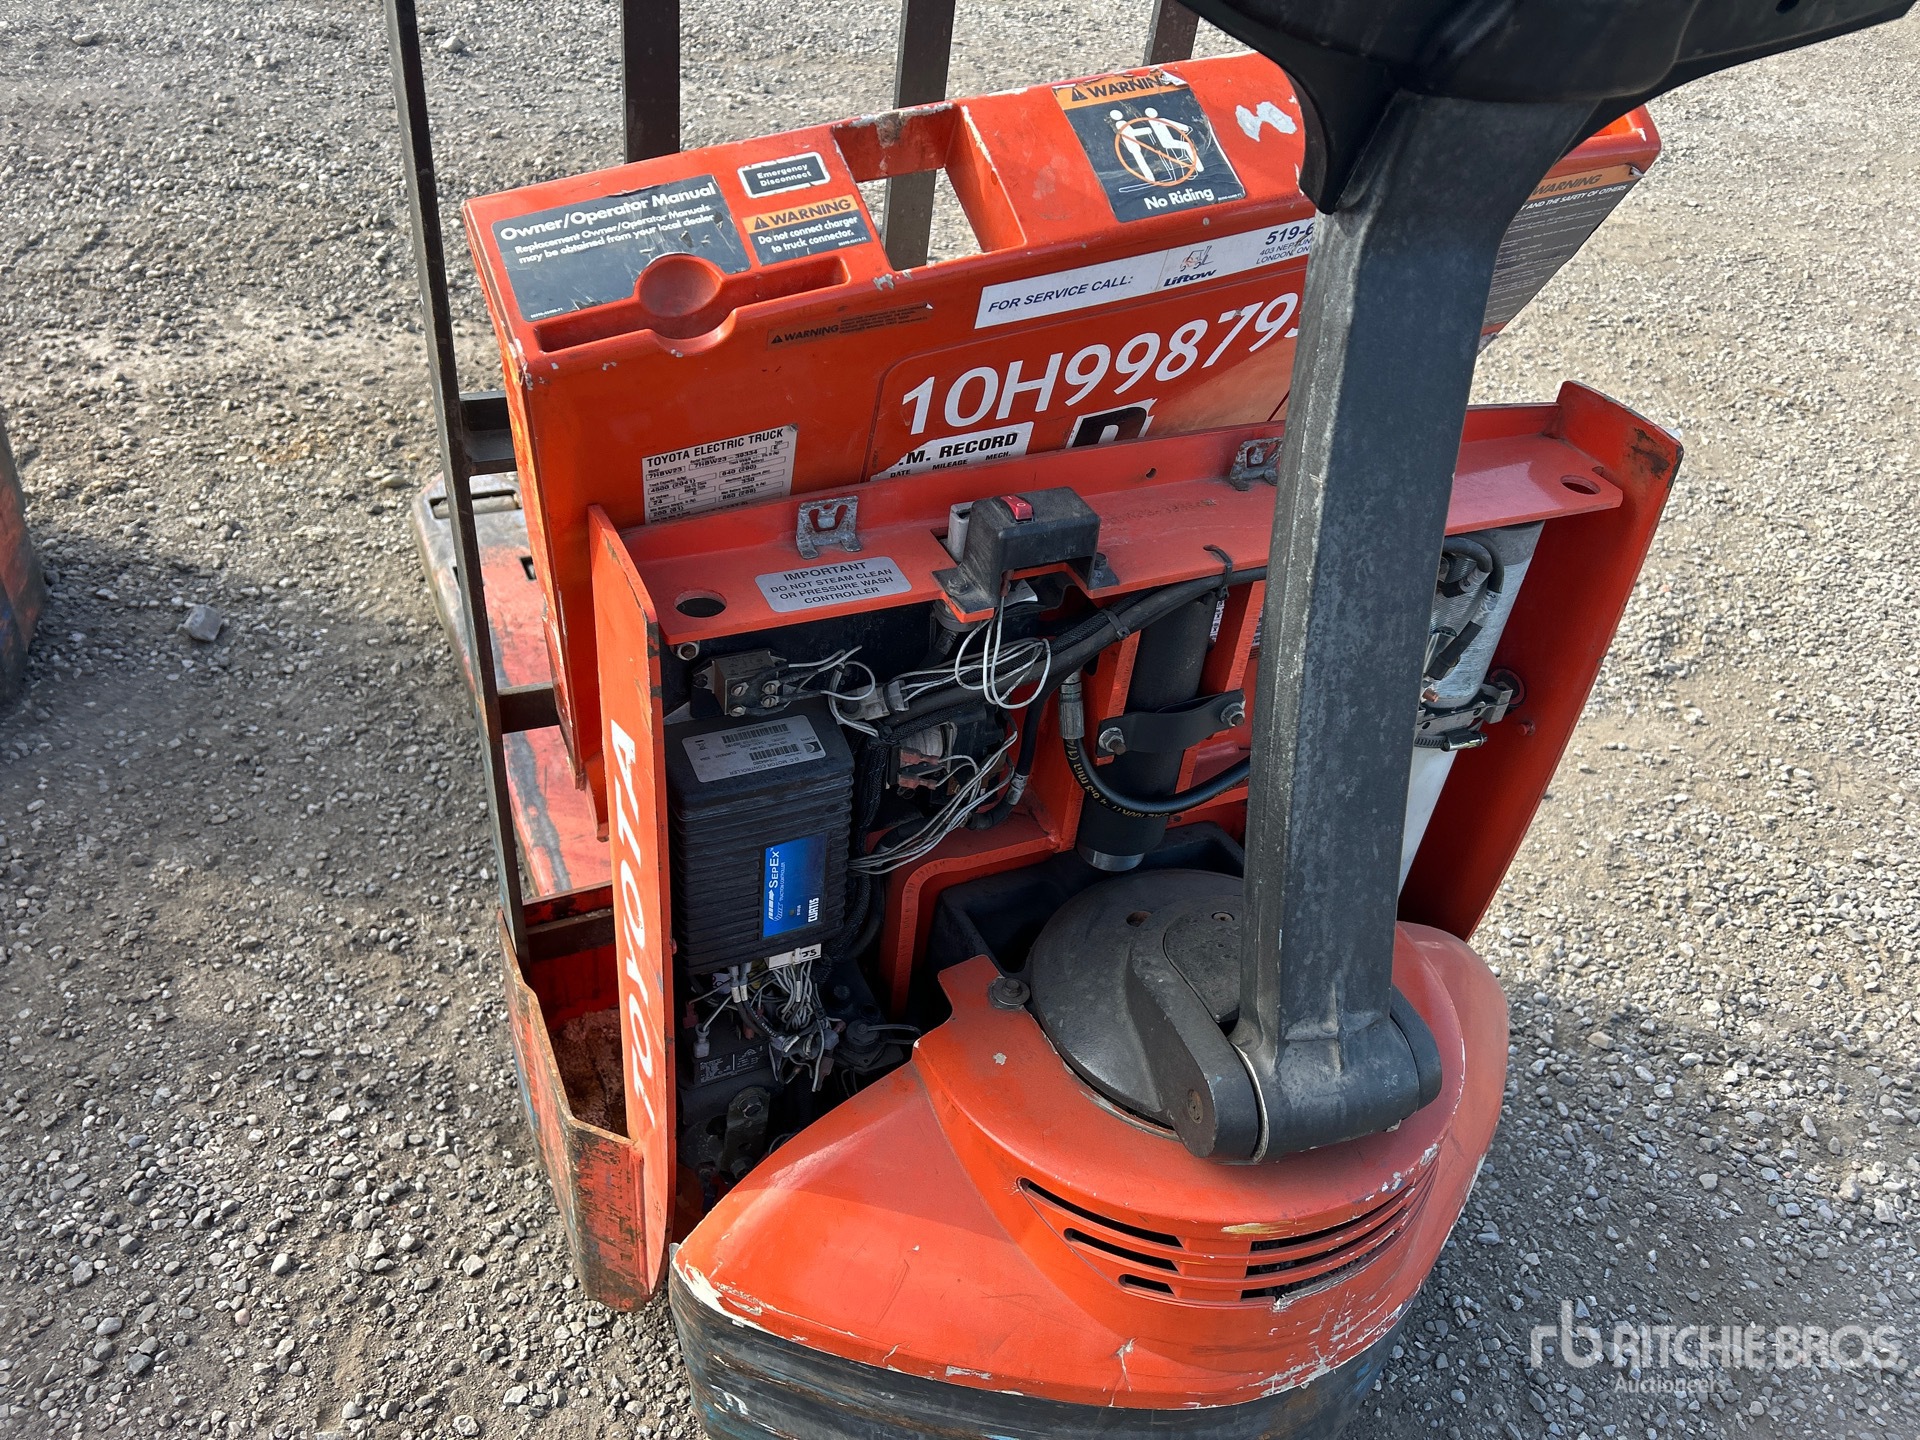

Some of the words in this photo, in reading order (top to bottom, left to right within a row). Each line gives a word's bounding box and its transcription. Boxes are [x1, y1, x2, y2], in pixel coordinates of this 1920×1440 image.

[1087, 74, 1167, 98] WARNIN
[756, 163, 808, 179] Emergency
[760, 170, 812, 187] Disconnect
[1526, 201, 1545, 210] AND
[1546, 198, 1560, 206] THE
[1560, 191, 1586, 203] SAFETY
[1586, 189, 1599, 197] OF
[1599, 184, 1628, 195] OTHERS
[1532, 174, 1603, 196] WARNING
[1144, 194, 1167, 210] No
[1174, 186, 1215, 205] Riding
[500, 198, 648, 241] Owner/Operator
[652, 182, 717, 207] Manual
[769, 199, 851, 226] WARNING
[514, 232, 580, 254] Replacement
[582, 213, 667, 239] Owner/Operator
[668, 203, 711, 219] Manuals
[518, 252, 542, 265] may
[544, 246, 559, 257] be
[560, 237, 606, 255] obtained
[606, 230, 632, 245] from
[632, 225, 657, 240] your
[658, 220, 682, 232] local
[682, 213, 714, 228] dealer
[757, 235, 772, 245] Do
[772, 230, 789, 240] not
[790, 223, 823, 238] connect
[824, 216, 858, 231] charger
[771, 245, 782, 254] to
[783, 238, 807, 251] truck
[808, 229, 855, 245] connector.
[1163, 268, 1217, 287] Liftow
[987, 297, 1022, 313] FOR
[1023, 283, 1088, 306] SERVICE
[1091, 275, 1134, 291] CALL:
[784, 324, 839, 342] WARNING
[902, 293, 1299, 435] 10H99879
[647, 451, 690, 468] TOYOTA
[694, 437, 745, 457] ELECTRIC
[748, 428, 784, 445] TRUCK
[898, 449, 932, 466] .M.
[938, 432, 1019, 459] RECORD
[932, 458, 968, 471] MILEAGE
[985, 450, 1012, 461] MECH.
[783, 562, 867, 581] IMPORTANT
[791, 581, 812, 590] NOT
[816, 575, 853, 586] STEAM
[856, 568, 893, 579] CLEAN
[780, 592, 797, 600] OR
[800, 582, 858, 596] PRESSURE
[862, 577, 893, 586] WASH
[804, 587, 880, 604] CONTROLLER
[808, 897, 820, 923] CURTIS
[611, 719, 656, 1129] TOYOTA
